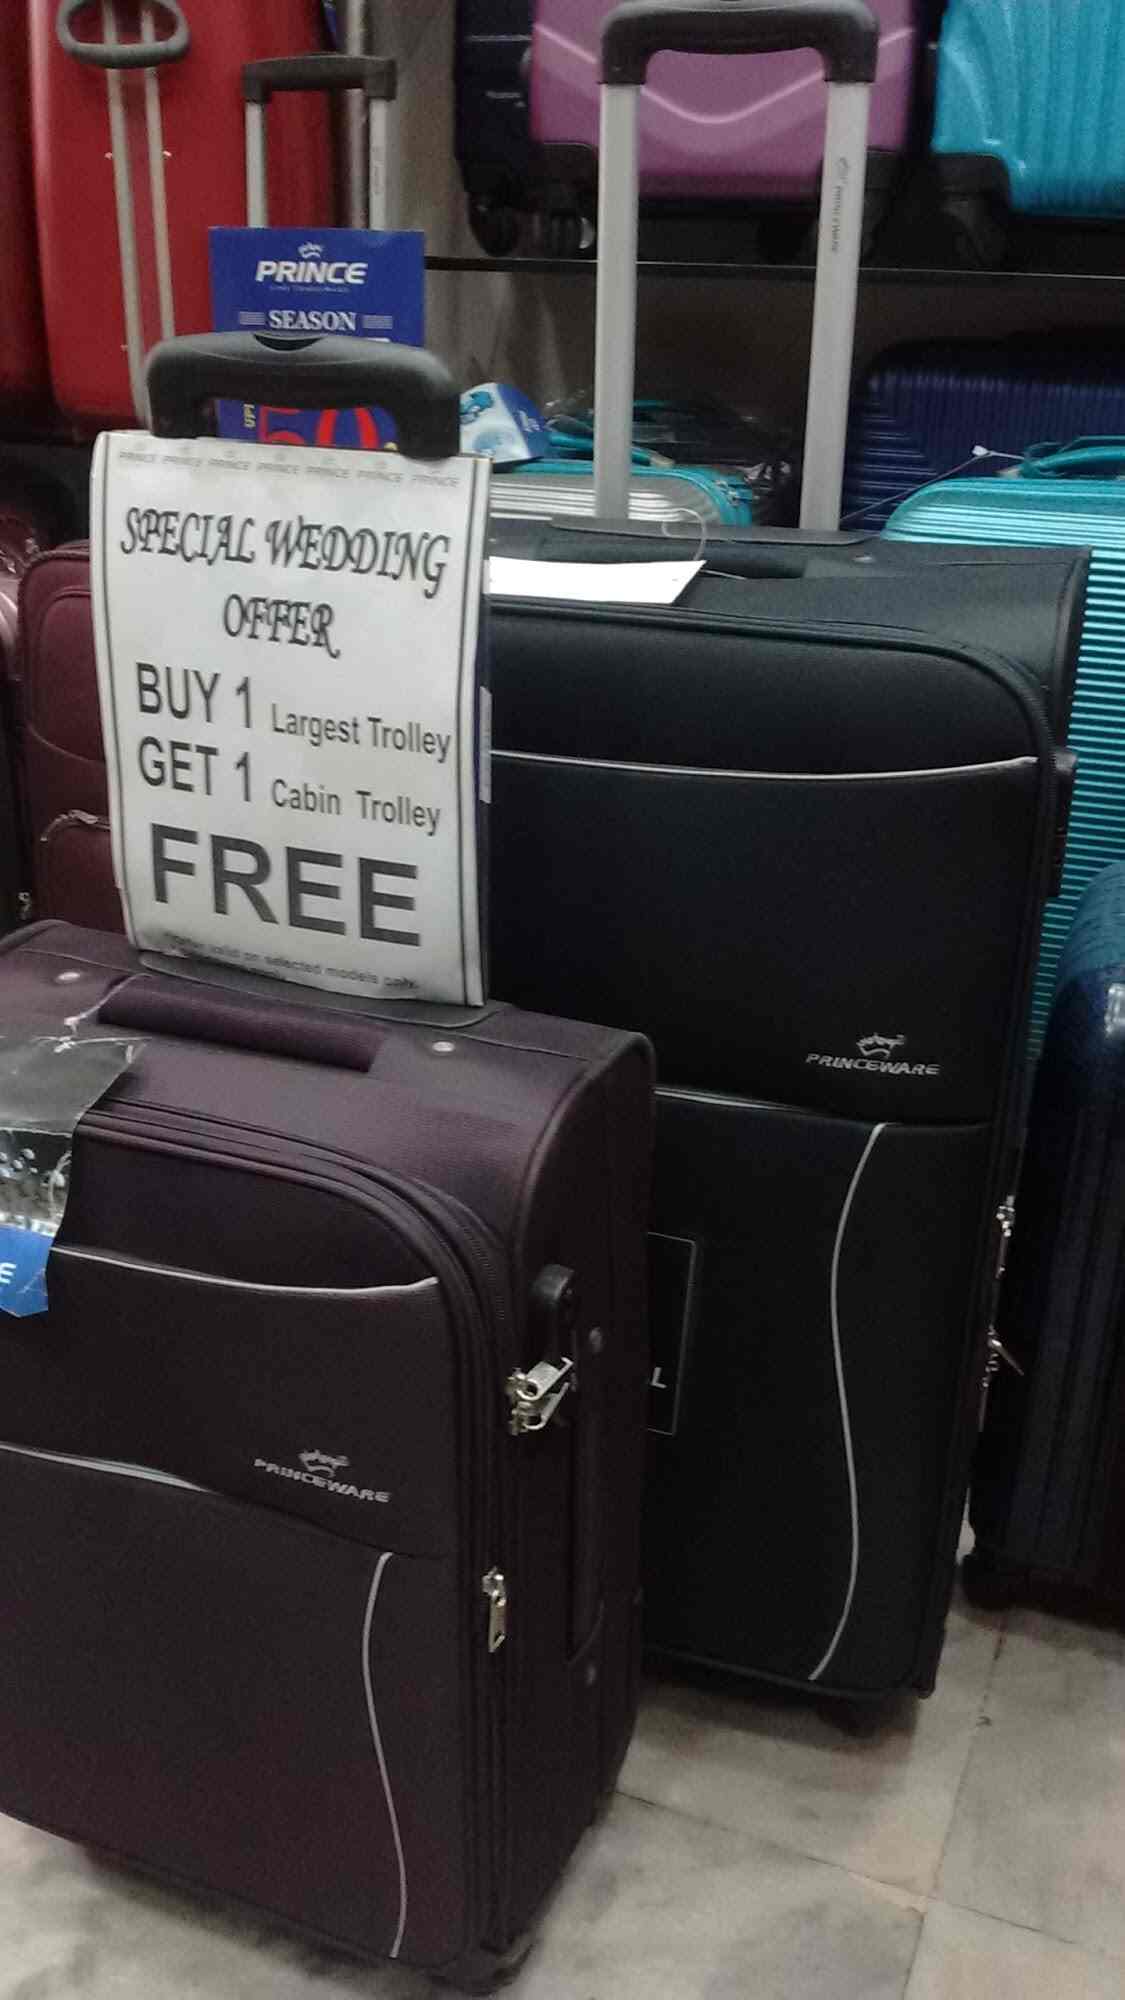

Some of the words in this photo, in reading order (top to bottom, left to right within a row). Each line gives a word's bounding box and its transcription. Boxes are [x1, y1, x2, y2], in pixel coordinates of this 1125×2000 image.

[255, 261, 368, 284] PRINCE
[268, 309, 357, 331] SEASON
[120, 507, 255, 566] SPECIAL
[265, 515, 451, 599] WEDDING
[223, 593, 341, 659] OFFER
[135, 662, 221, 724] BUY
[235, 676, 252, 729] 1
[271, 703, 361, 747] Largest
[367, 716, 452, 764] Trolley
[138, 735, 220, 797] GET
[235, 751, 252, 802] 1
[271, 778, 342, 816] Cabin
[356, 790, 442, 837] Trolley
[150, 823, 422, 948] FREE
[806, 1053, 941, 1076] PRINCEWARE
[254, 1458, 391, 1503] PRINCEWARE
